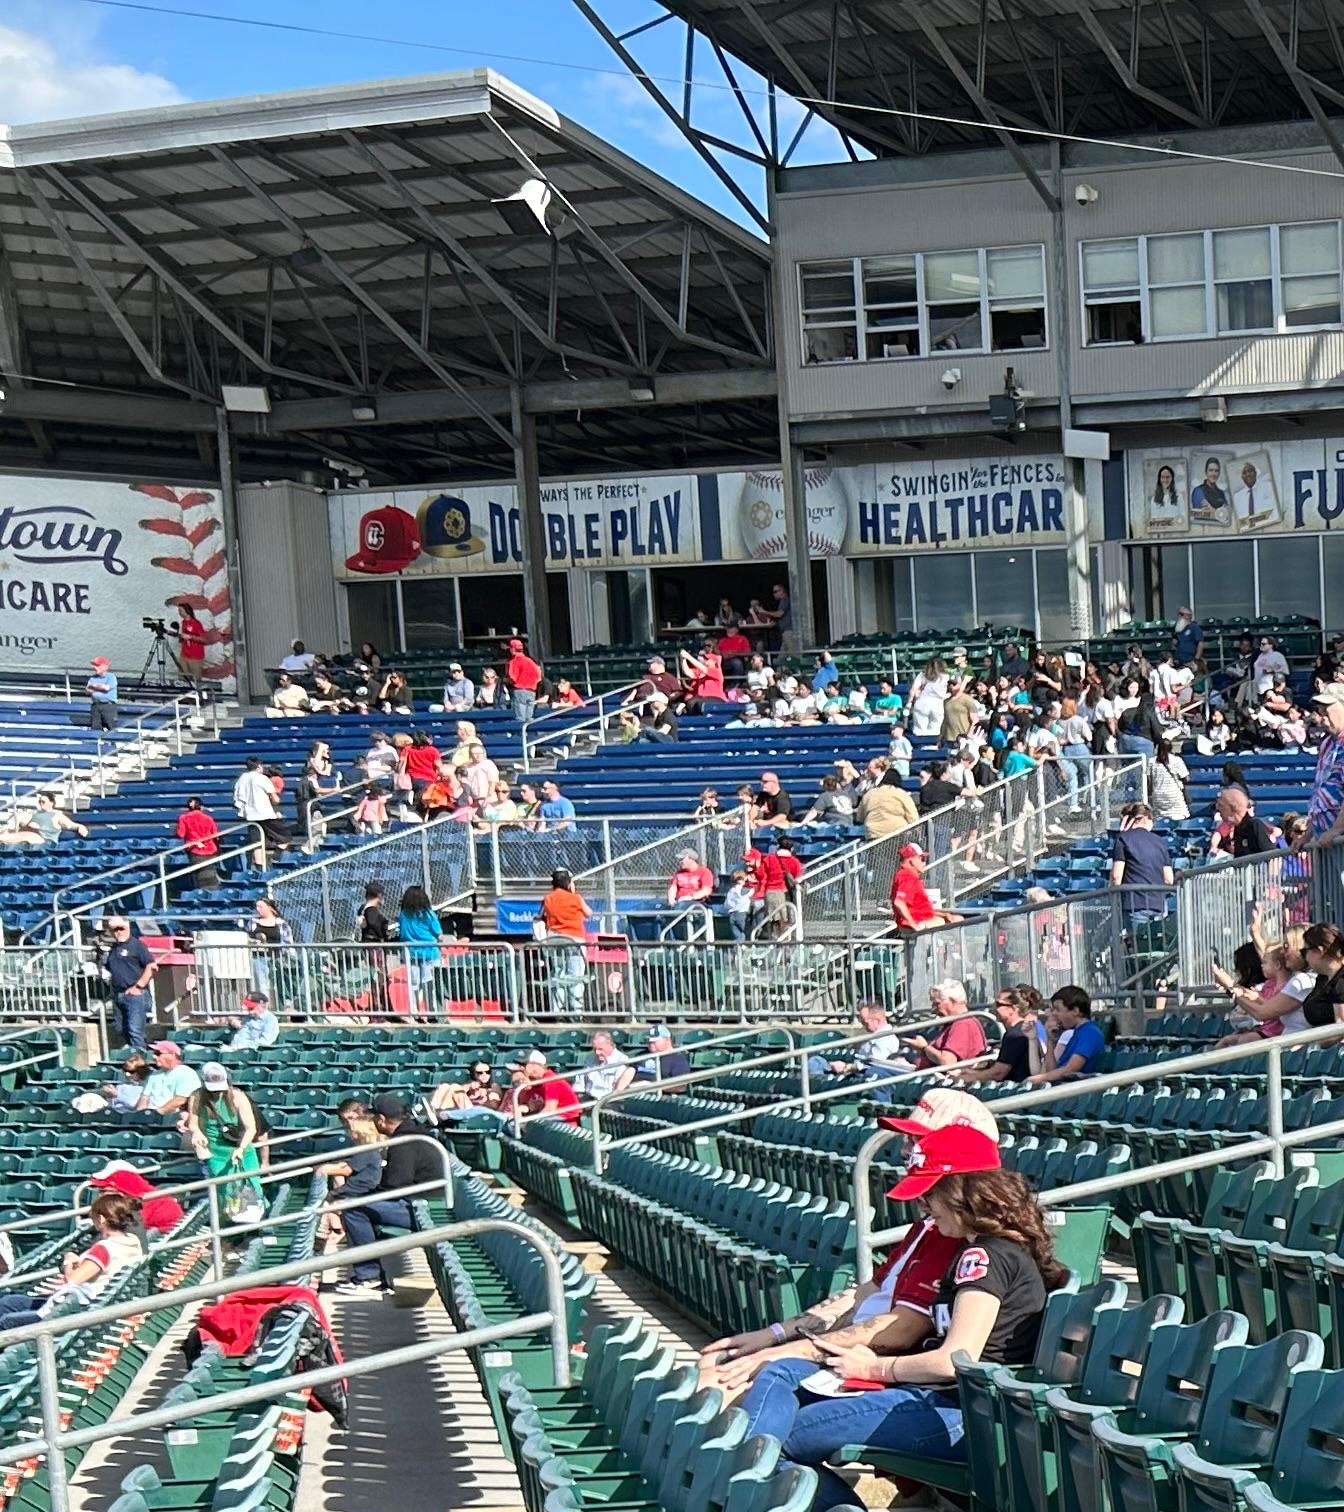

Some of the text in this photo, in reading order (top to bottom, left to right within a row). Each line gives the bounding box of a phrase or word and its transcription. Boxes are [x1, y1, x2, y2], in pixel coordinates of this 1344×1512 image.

[540, 484, 640, 502] WAYS THE PERFECT
[990, 463, 1055, 487] FENCES
[611, 490, 681, 557] PLAY
[858, 488, 1065, 545] HEALTHCAR
